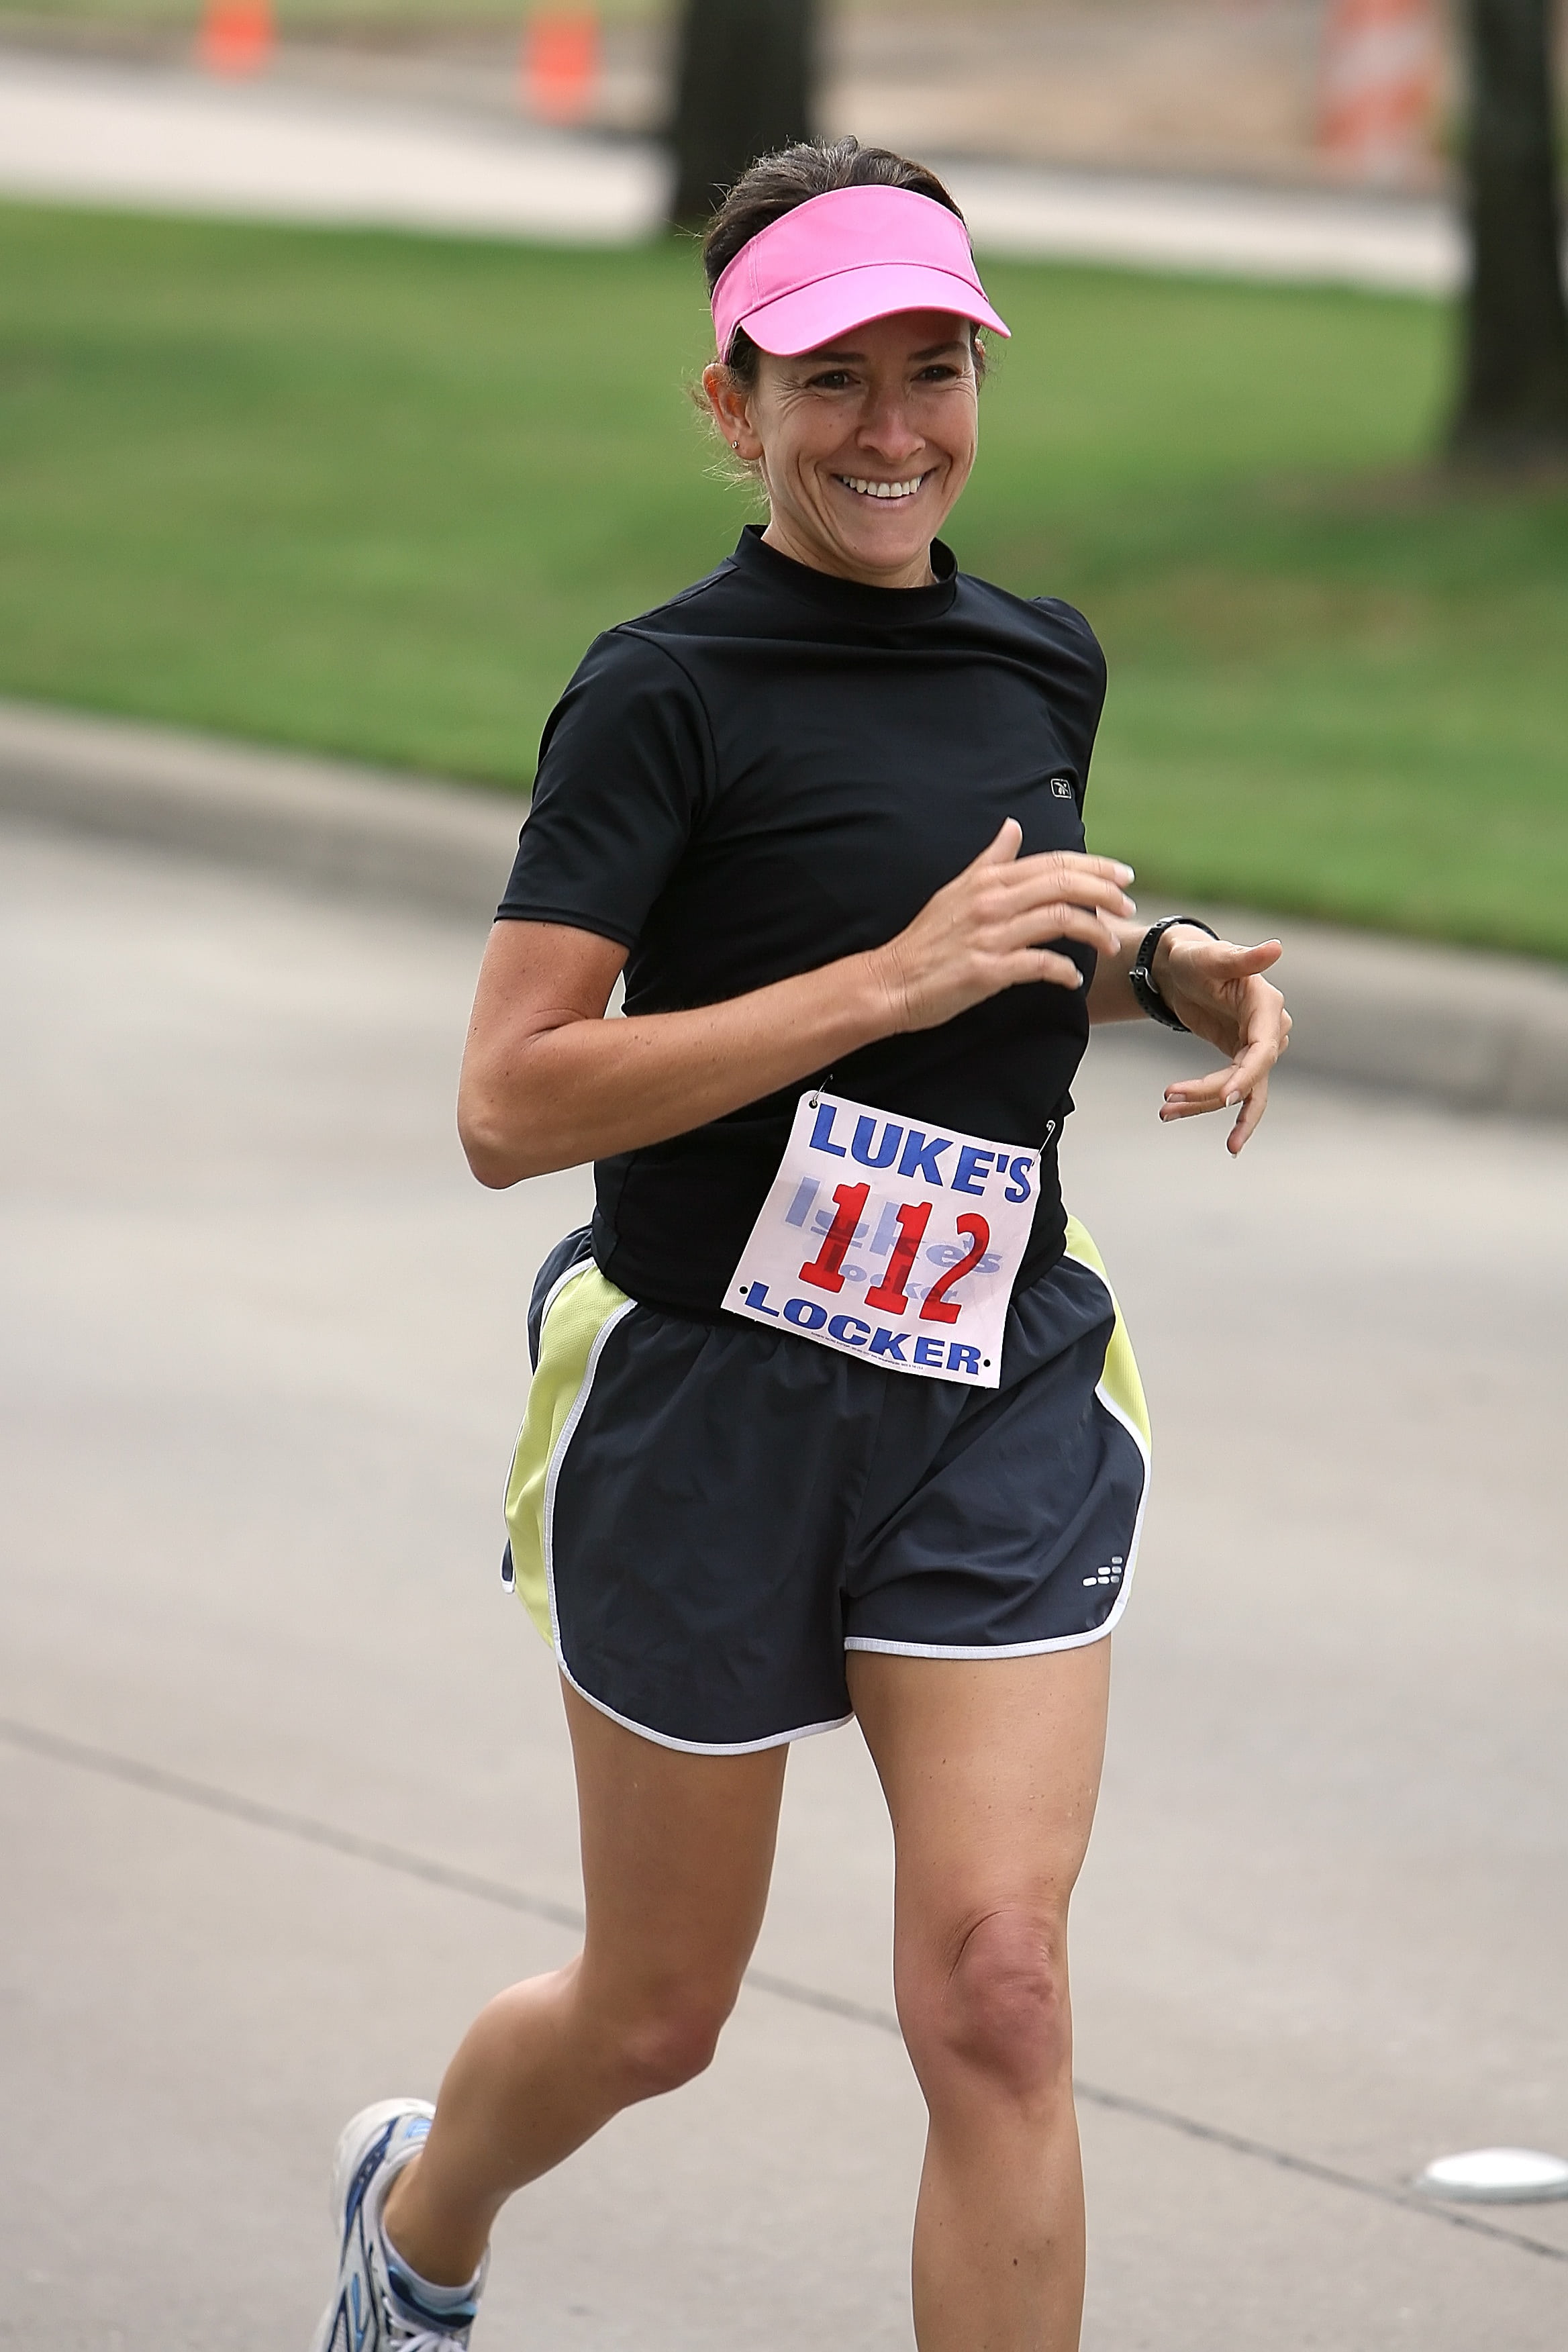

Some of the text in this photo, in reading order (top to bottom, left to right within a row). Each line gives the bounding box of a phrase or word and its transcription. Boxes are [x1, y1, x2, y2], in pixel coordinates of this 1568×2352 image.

[809, 1103, 1033, 1204] LUKE'S
[798, 1182, 990, 1324] 112
[744, 1281, 981, 1375] LOCKER
